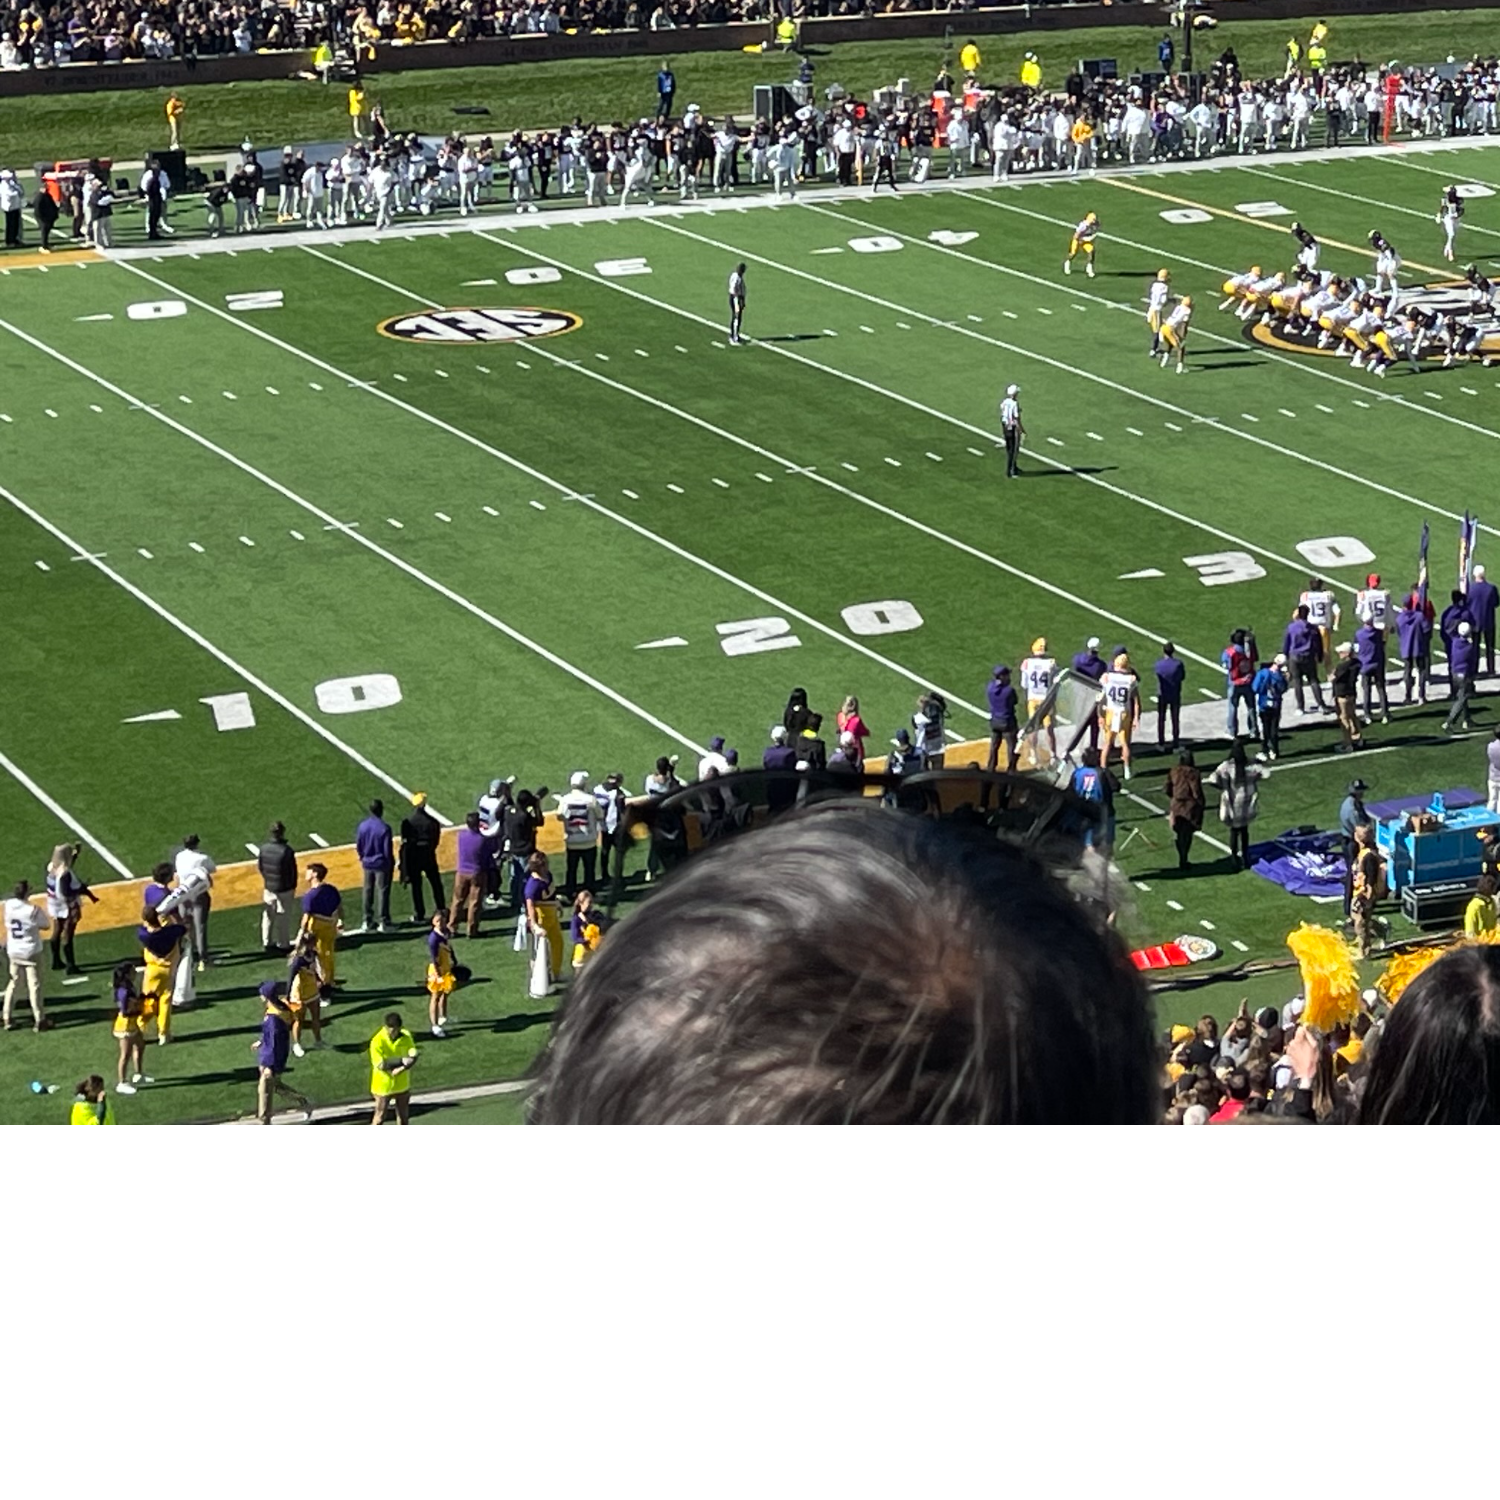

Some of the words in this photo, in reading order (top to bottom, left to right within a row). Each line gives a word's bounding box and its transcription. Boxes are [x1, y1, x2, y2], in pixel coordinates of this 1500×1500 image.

[1182, 536, 1376, 586] 30
[1311, 602, 1326, 617] 13
[715, 601, 925, 656] 20
[1030, 671, 1049, 688] 44
[199, 673, 403, 731] 10
[1108, 686, 1128, 703] 49
[11, 918, 24, 939] 2
